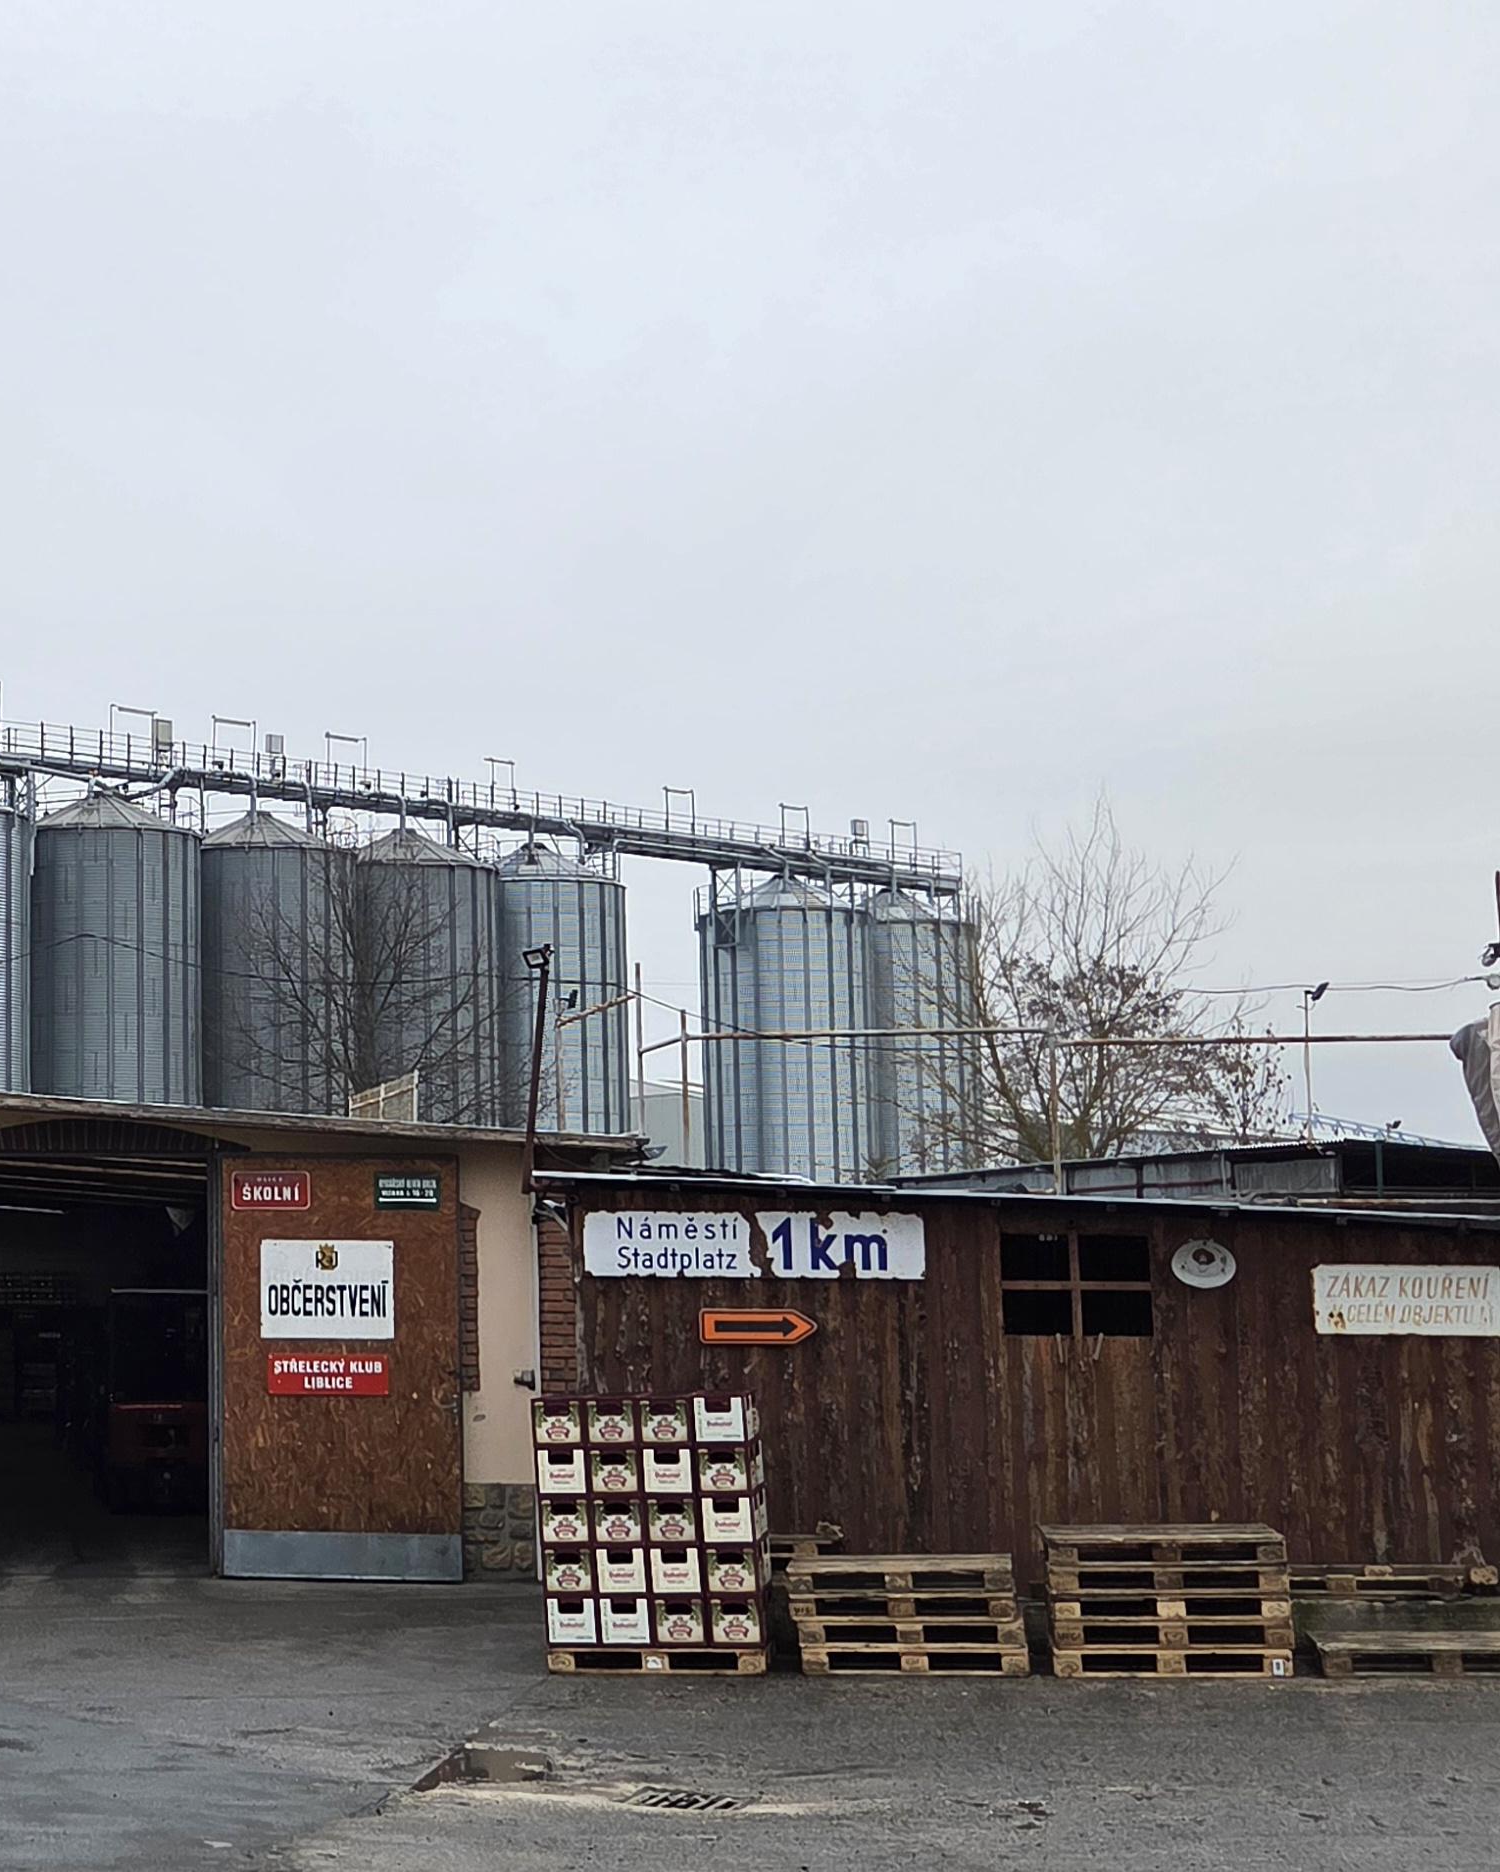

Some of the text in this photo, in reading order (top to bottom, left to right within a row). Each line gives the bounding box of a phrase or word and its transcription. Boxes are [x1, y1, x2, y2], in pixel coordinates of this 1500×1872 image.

[242, 1181, 300, 1201] ŠKOLNÍ
[616, 1216, 739, 1240] Náměstí
[771, 1216, 888, 1271] 1 km
[617, 1246, 739, 1275] Stadtplatz
[268, 1278, 389, 1318] OBČERSTVENÍ
[1326, 1272, 1491, 1300] ZÁKAZ KOUŘENÍ
[1399, 1303, 1475, 1326] OBJEKTU
[273, 1358, 383, 1375] STŘELECKÝ KLUB
[303, 1376, 354, 1390] LIBLICE
